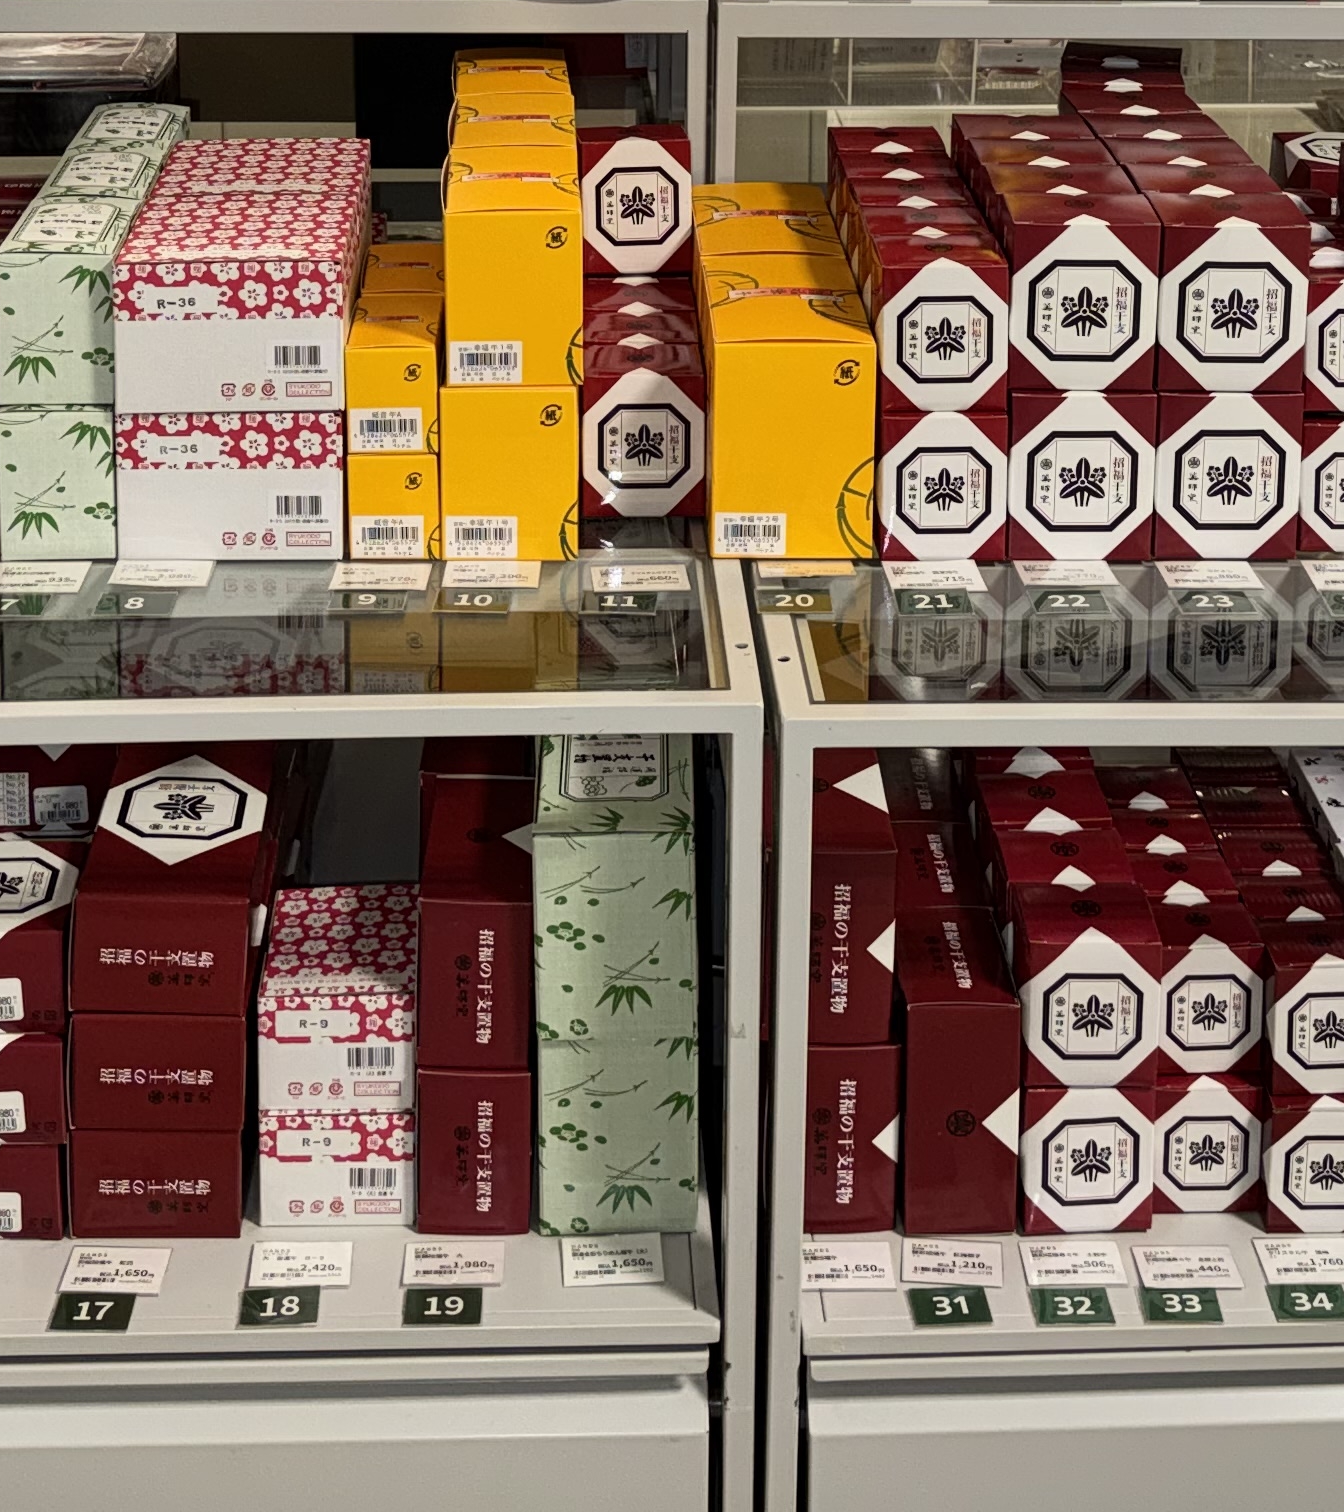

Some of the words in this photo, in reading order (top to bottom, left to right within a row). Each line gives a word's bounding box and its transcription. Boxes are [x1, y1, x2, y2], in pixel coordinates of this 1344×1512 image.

[156, 295, 196, 310] R-36
[159, 443, 198, 456] R-36
[124, 598, 145, 610] 8
[453, 594, 493, 607] 10
[600, 594, 638, 607] 11
[775, 595, 814, 607] 20
[913, 595, 953, 608] 21
[1047, 595, 1089, 607] 22
[1191, 595, 1233, 609] 23
[299, 1019, 328, 1029] R-9
[259, 1297, 300, 1316] 18
[424, 1297, 464, 1315] 19
[933, 1297, 969, 1315] 31
[1054, 1297, 1094, 1314] 32
[1163, 1295, 1202, 1312] 33
[1294, 1292, 1332, 1311] 34
[72, 1301, 113, 1320] 17
